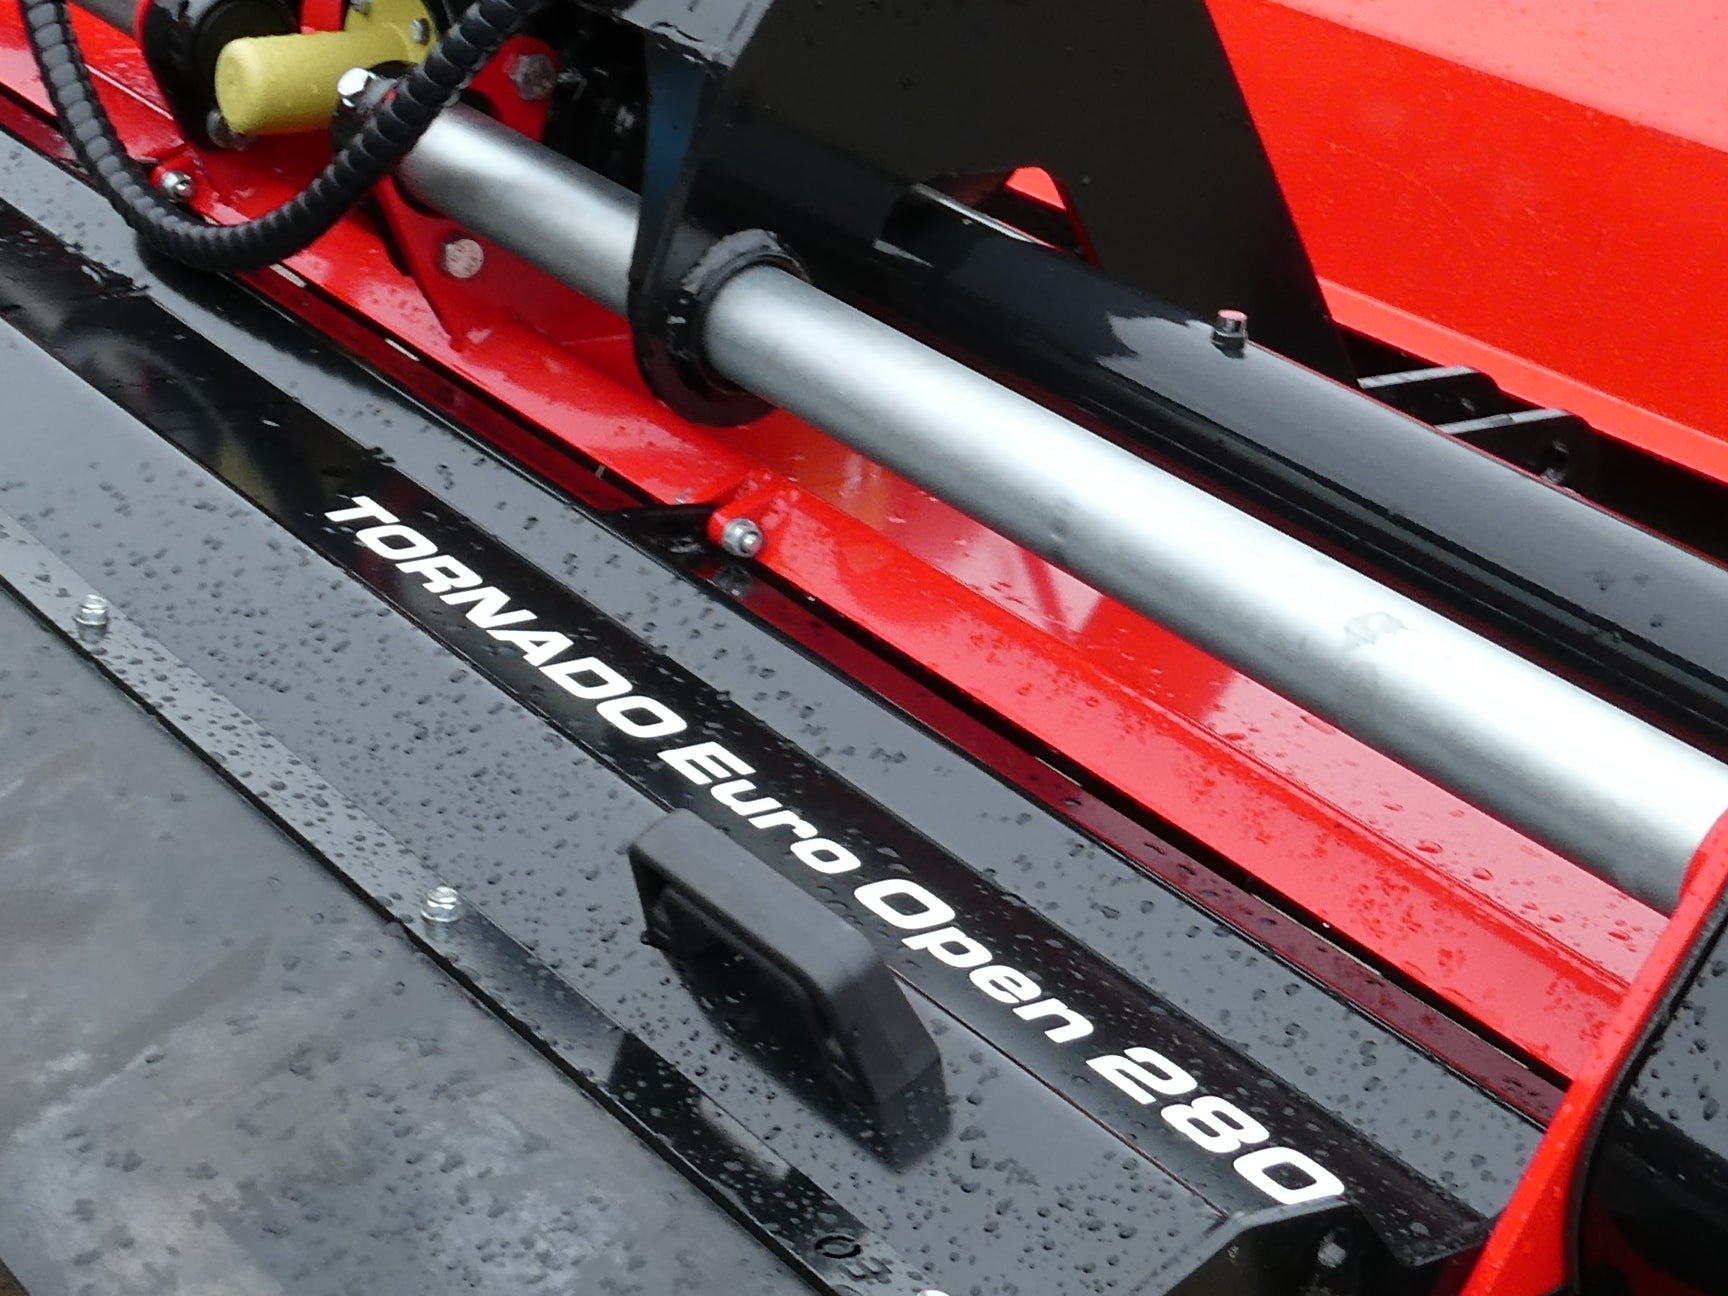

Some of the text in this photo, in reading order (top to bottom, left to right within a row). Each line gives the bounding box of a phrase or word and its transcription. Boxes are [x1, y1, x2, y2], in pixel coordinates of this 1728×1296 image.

[325, 495, 1345, 1205] TORNADO Euro Open 280
